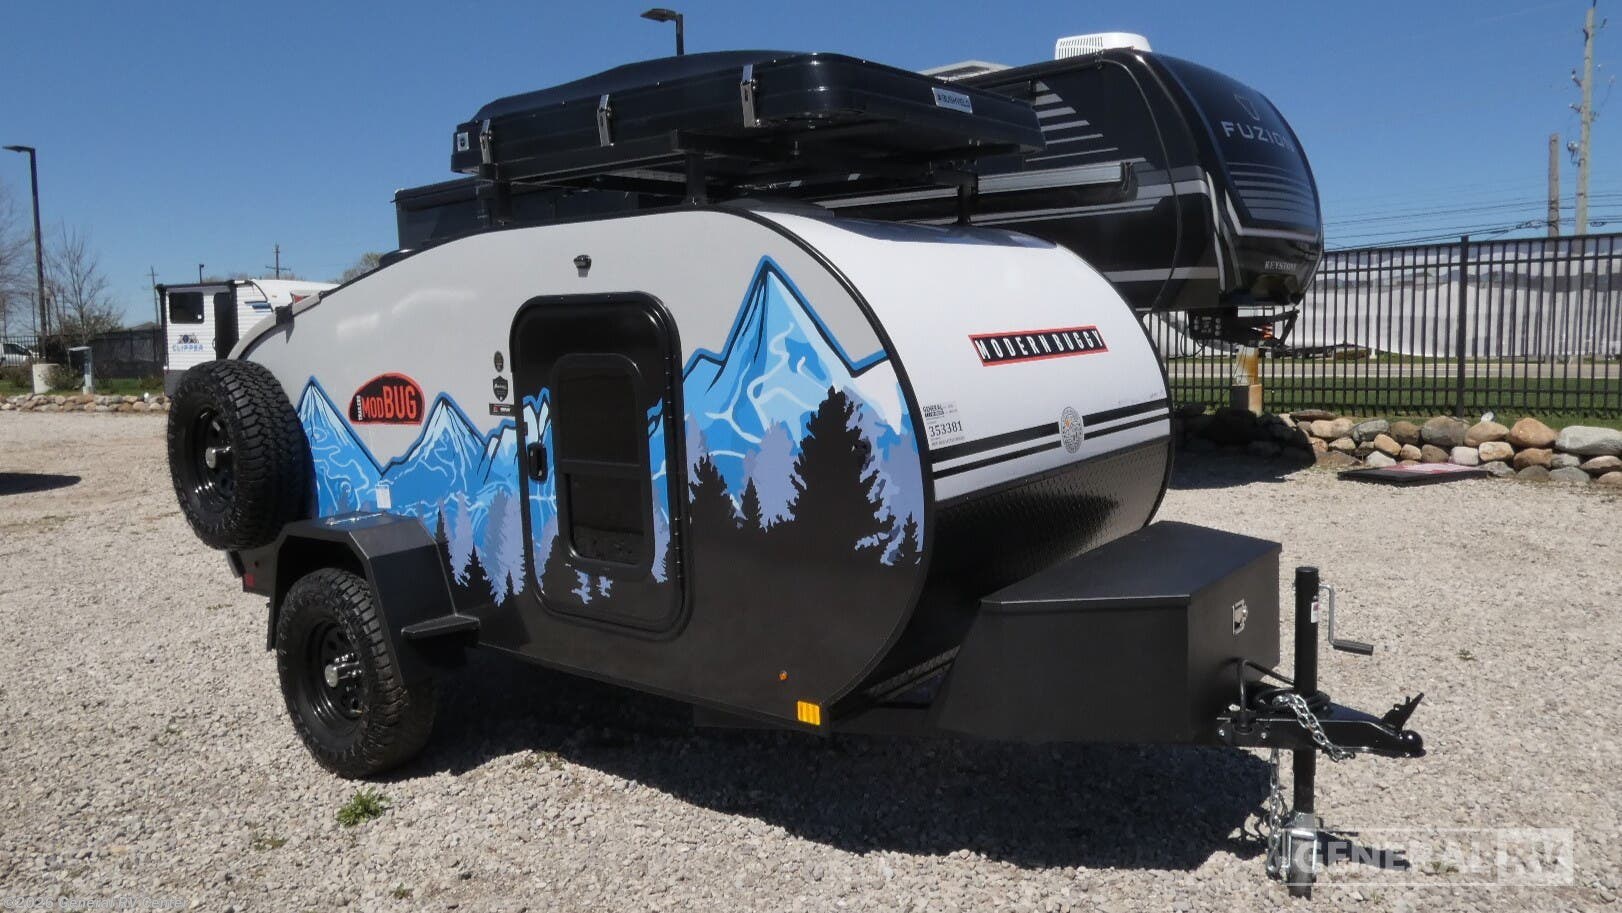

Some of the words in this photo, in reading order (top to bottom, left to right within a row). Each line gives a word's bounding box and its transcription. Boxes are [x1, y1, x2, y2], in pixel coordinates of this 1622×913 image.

[1221, 120, 1295, 153] FUZION
[974, 335, 1052, 360] MODERN
[1052, 330, 1103, 351] BUGGY
[362, 385, 417, 419] MODBUG
[929, 420, 962, 437] 353381
